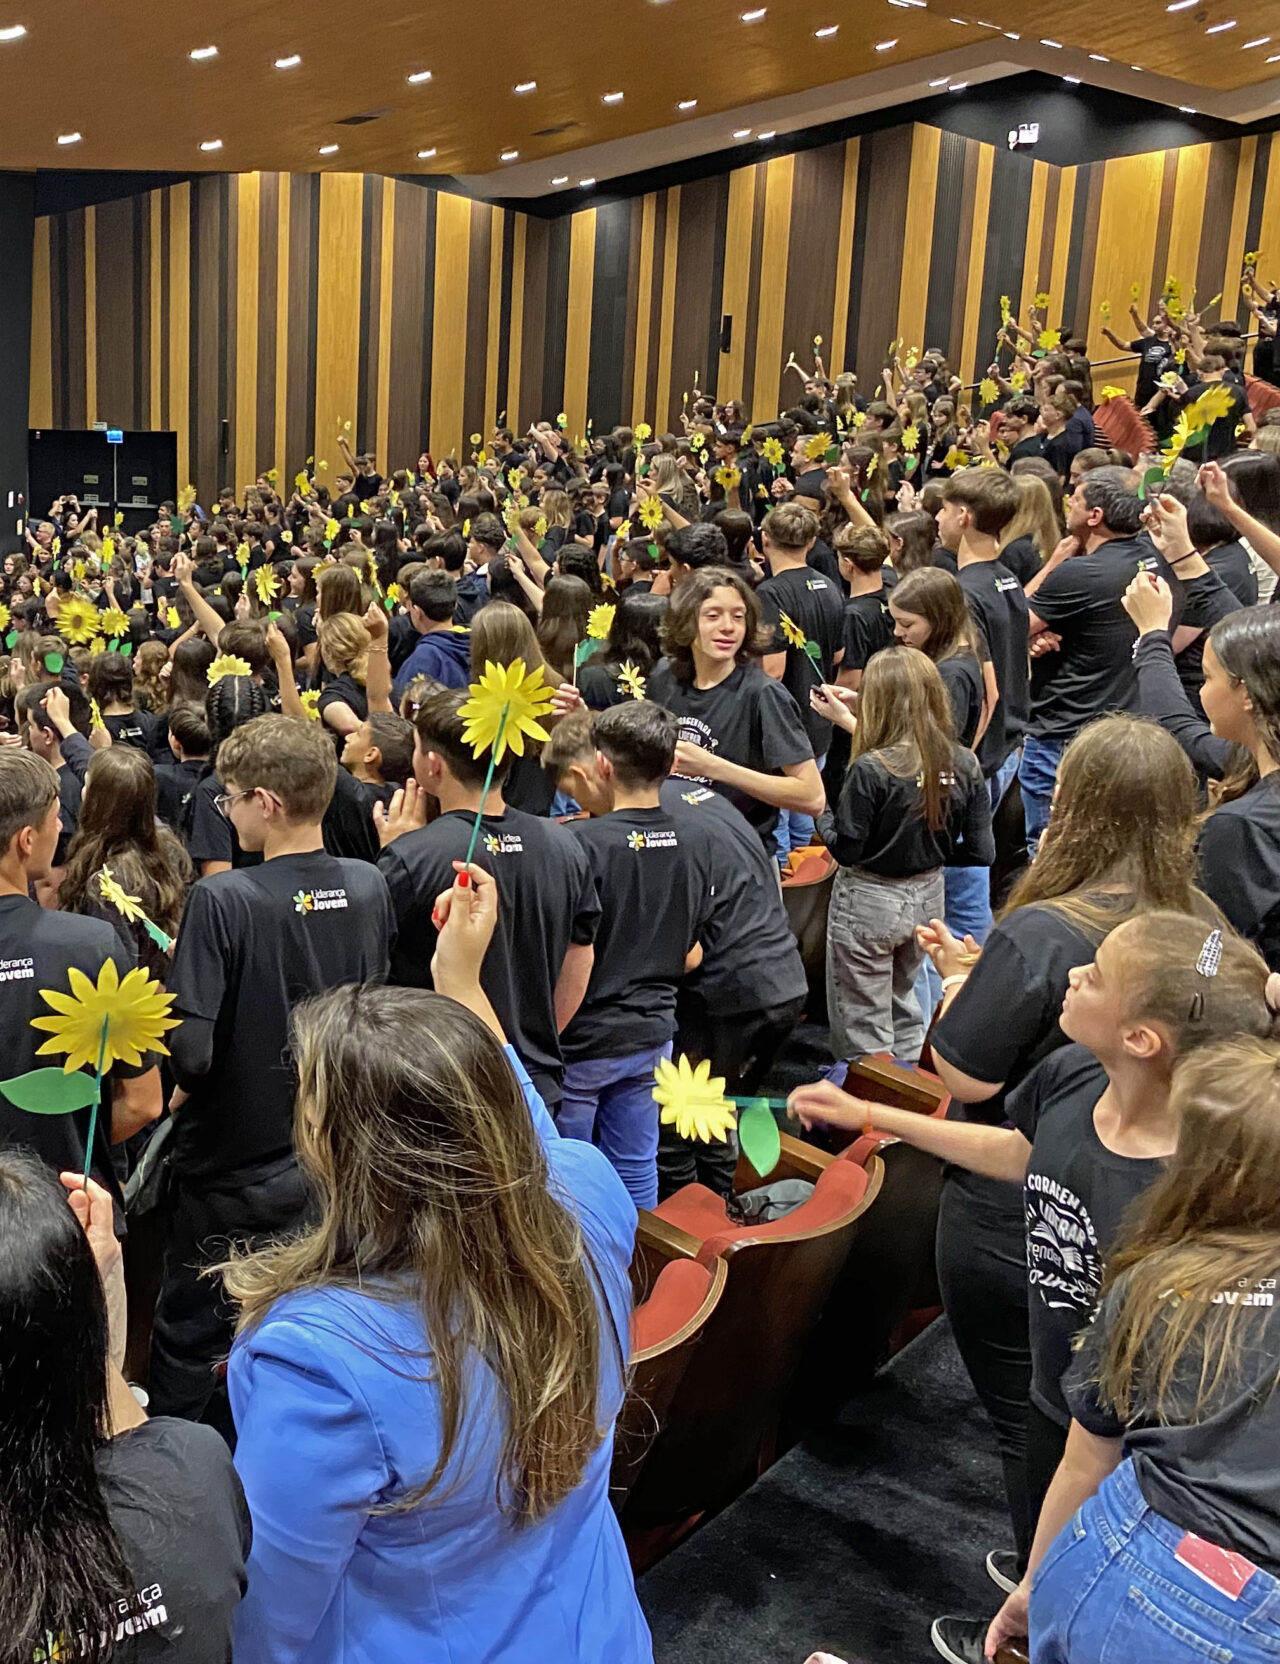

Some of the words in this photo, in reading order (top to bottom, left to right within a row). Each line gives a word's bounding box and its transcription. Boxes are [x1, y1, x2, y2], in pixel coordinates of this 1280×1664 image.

[645, 838, 678, 848] Jovem
[310, 889, 346, 900] Liderança
[313, 898, 349, 911] Jovem
[1210, 1290, 1274, 1306] ovem
